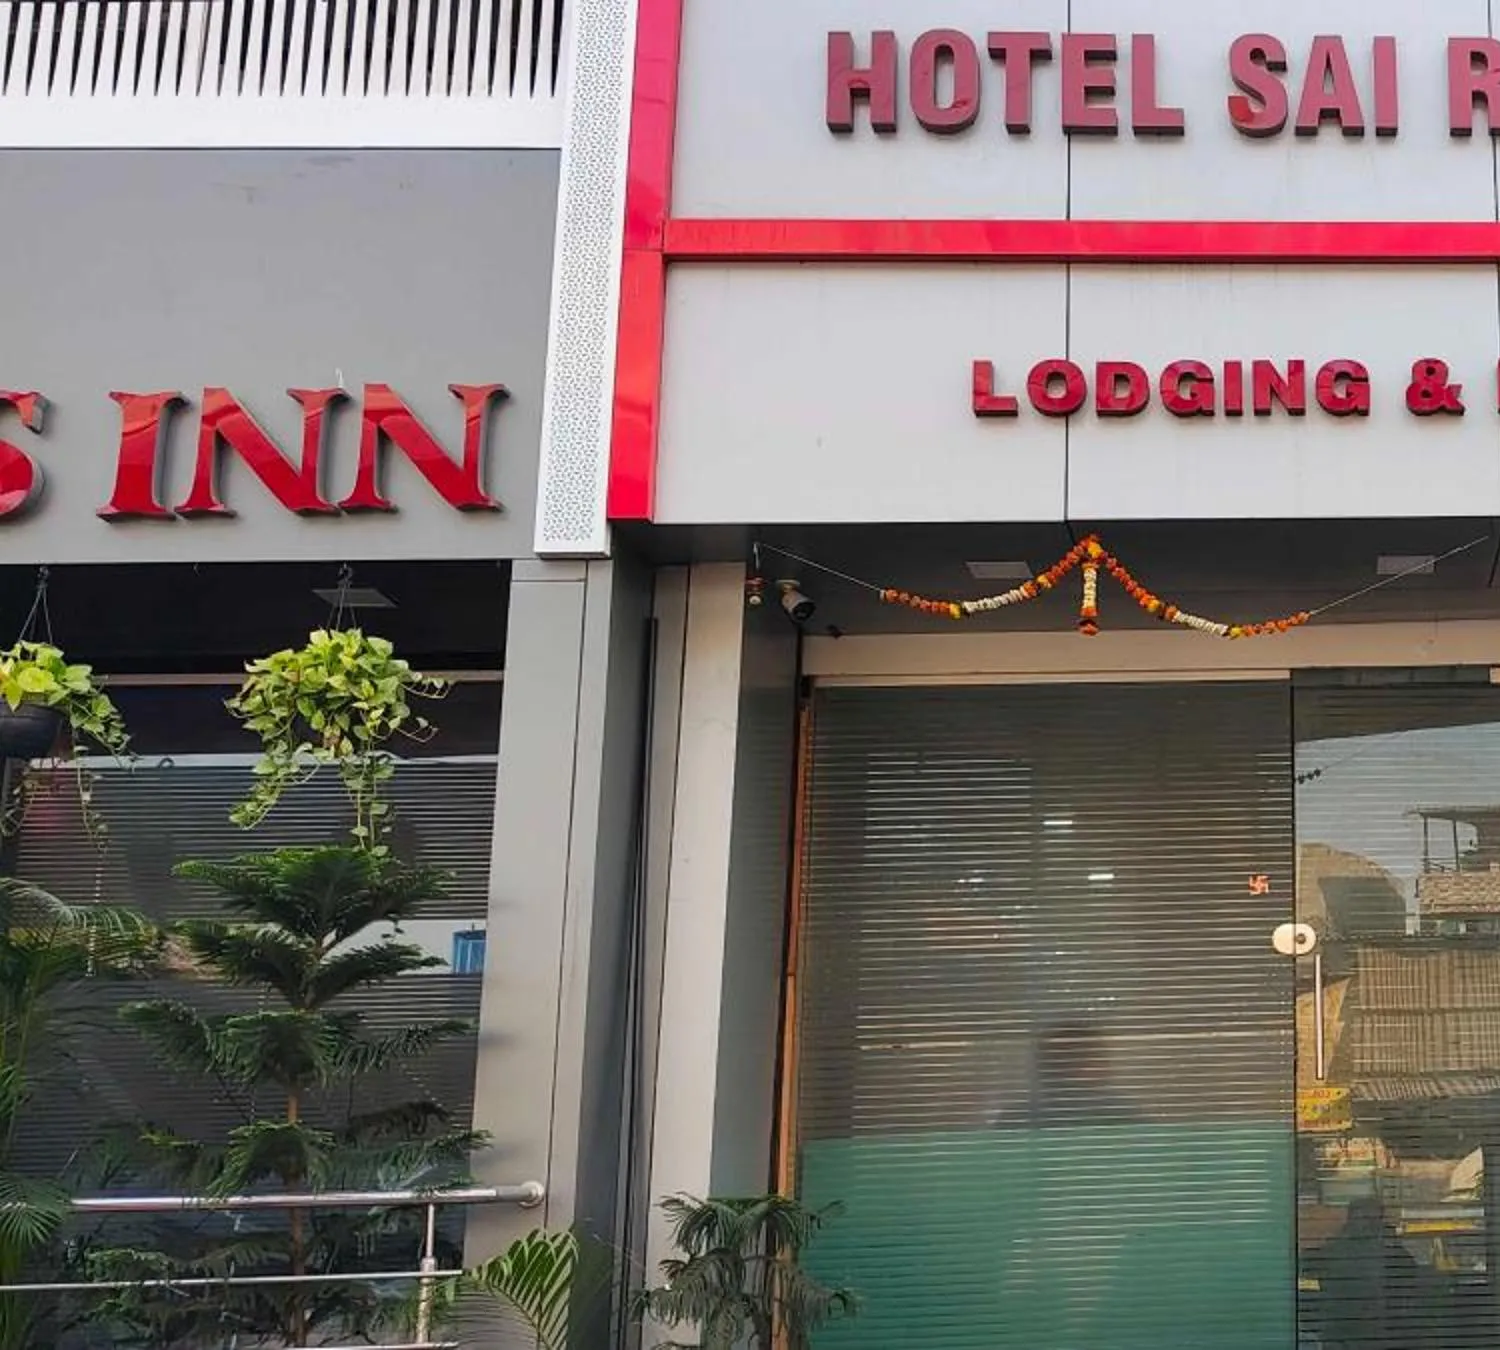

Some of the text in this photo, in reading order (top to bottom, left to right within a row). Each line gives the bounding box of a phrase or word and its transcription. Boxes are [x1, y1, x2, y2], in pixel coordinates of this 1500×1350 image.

[825, 28, 1186, 137] HOTEL
[1226, 32, 1399, 139] SAI
[971, 359, 1372, 419] LODGING
[1404, 357, 1465, 417] &
[96, 383, 512, 523] INN
